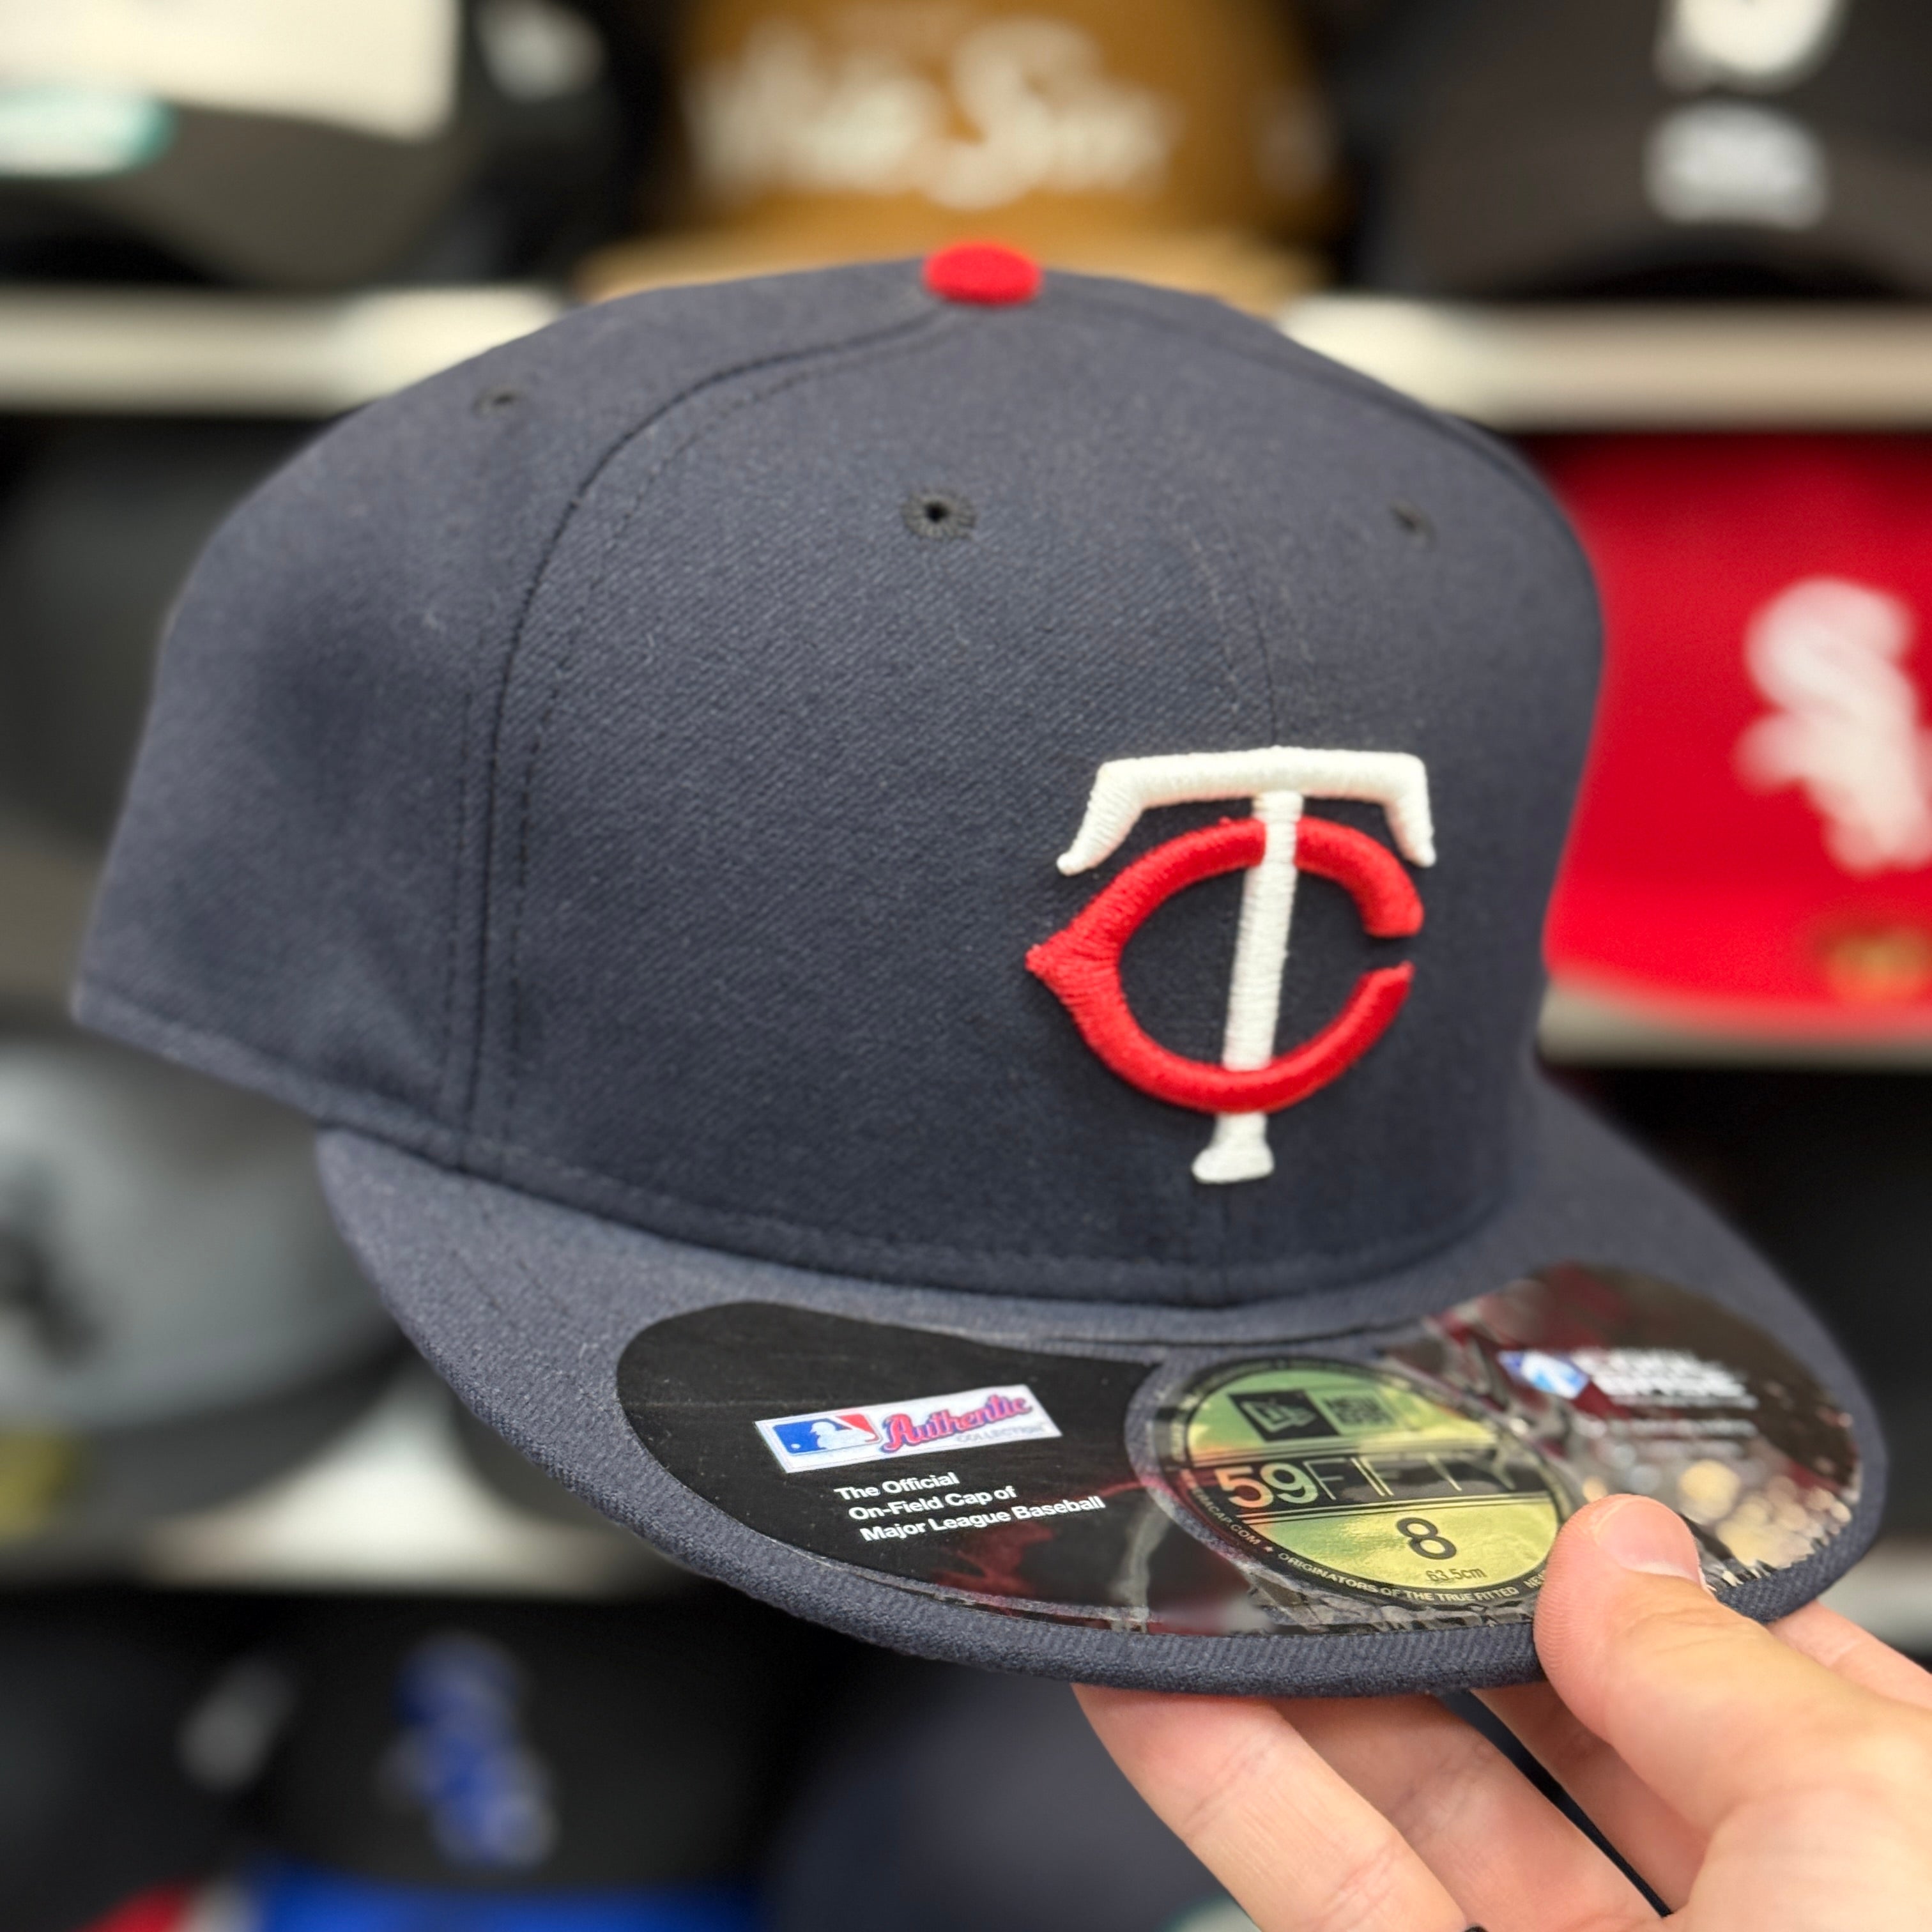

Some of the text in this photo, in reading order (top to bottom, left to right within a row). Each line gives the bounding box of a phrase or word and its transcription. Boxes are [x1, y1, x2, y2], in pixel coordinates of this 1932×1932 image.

[880, 1394, 1032, 1453] Authentic
[834, 1472, 960, 1501] The Official
[848, 1485, 1017, 1521] On-Field Cap of
[859, 1496, 1105, 1542] Major League Baseball
[1397, 1517, 1457, 1560] 8
[1278, 1552, 1379, 1593] ORIGINATORS
[1379, 1587, 1401, 1597] OF
[1406, 1590, 1435, 1602] THE
[1436, 1593, 1473, 1602] TRUE
[1472, 1586, 1519, 1601] FITTED
[1425, 1568, 1487, 1582] 63.5cm
